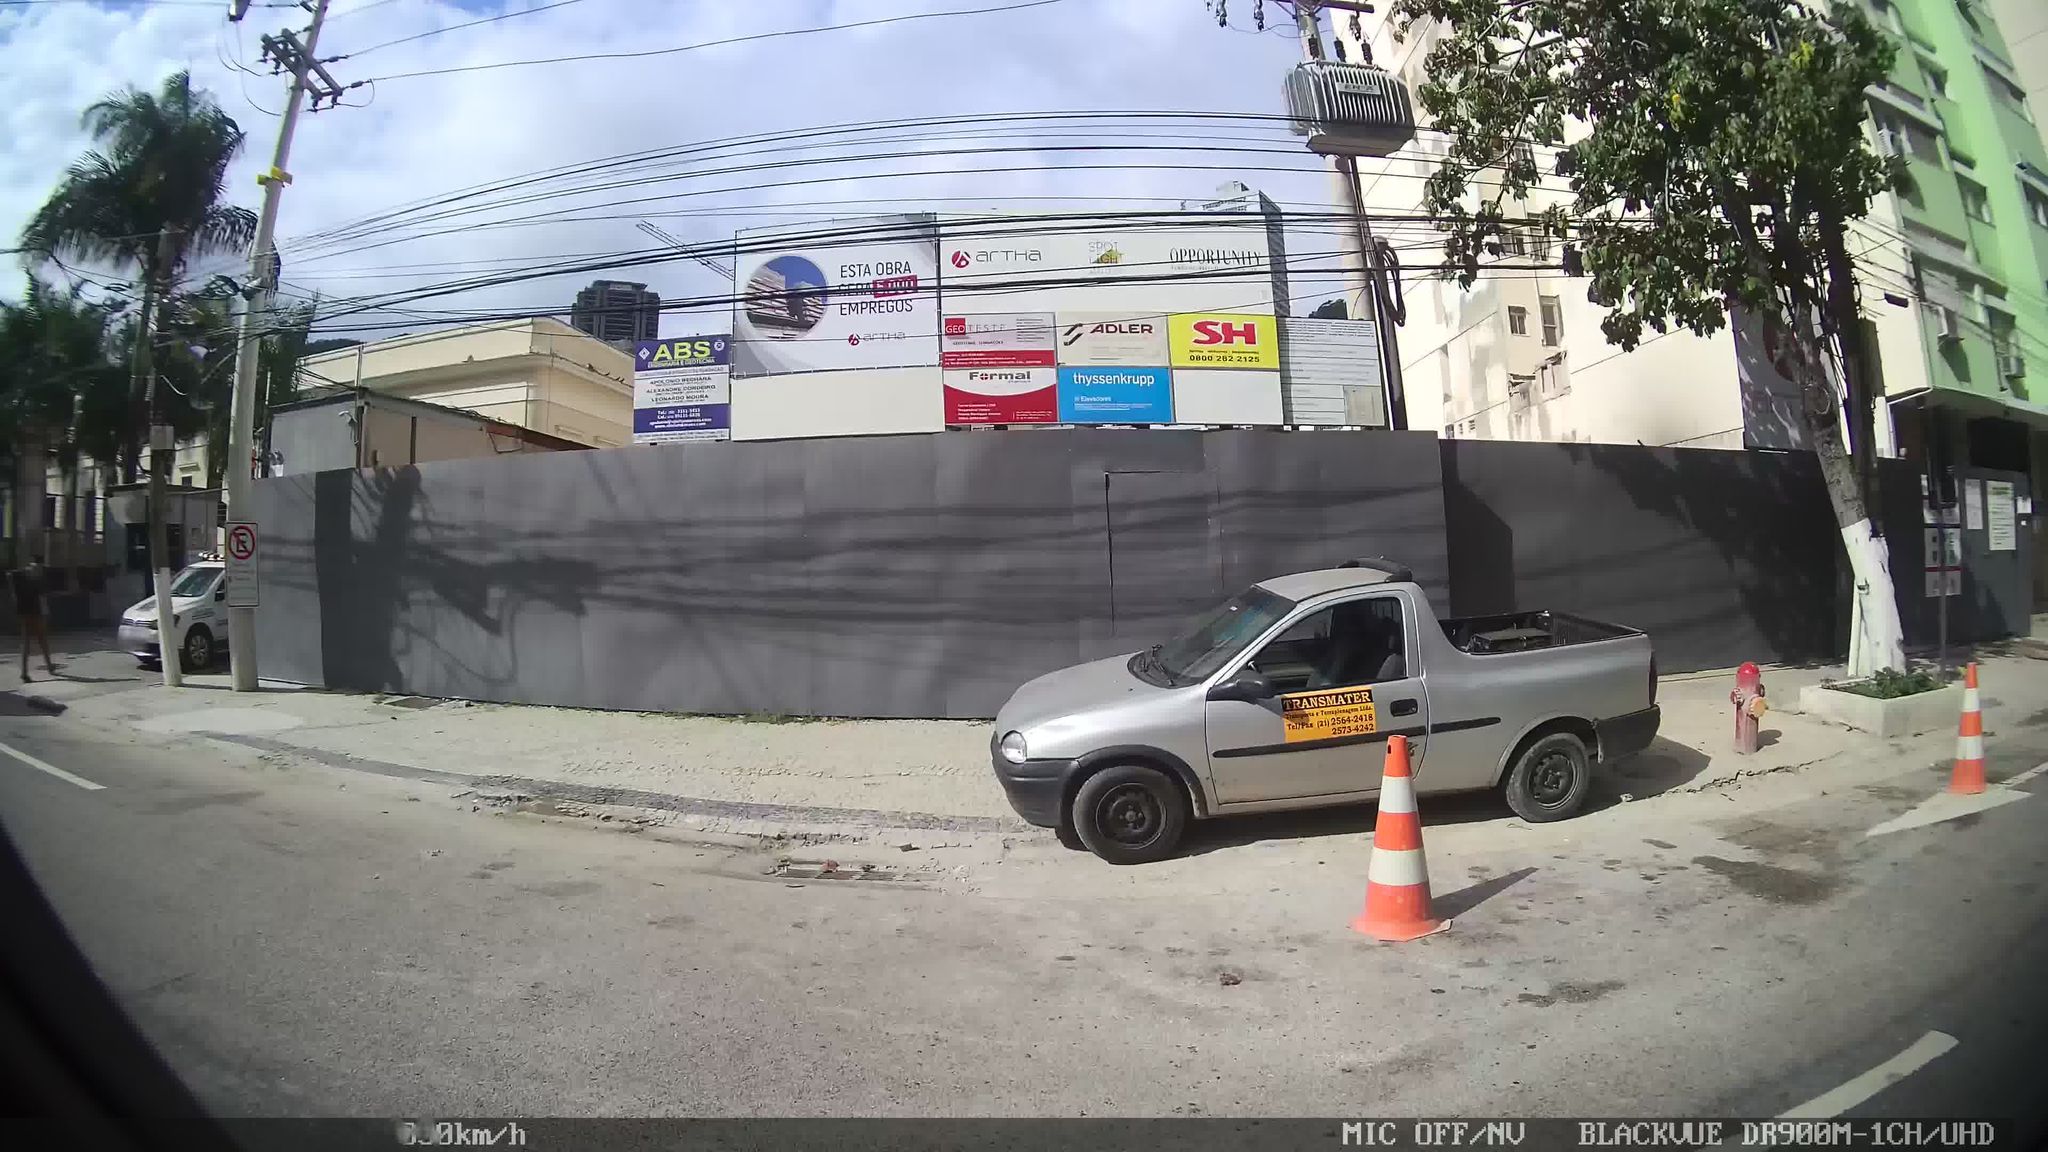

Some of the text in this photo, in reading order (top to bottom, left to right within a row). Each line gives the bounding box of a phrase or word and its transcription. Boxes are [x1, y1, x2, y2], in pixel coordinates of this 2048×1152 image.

[1169, 247, 1261, 266] OPPORTUNITY
[840, 261, 912, 278] ESTA OBRA
[840, 298, 913, 316] EMPREGOS
[1090, 323, 1153, 334] ADLER
[1193, 321, 1257, 345] SH
[653, 341, 711, 362] ABS
[1236, 354, 1260, 362] 2125
[1073, 372, 1155, 387] thyssenkrupp
[1283, 692, 1371, 710] TRANSMATER
[1331, 714, 1374, 725] 2564-2418
[1331, 724, 1374, 735] 2573-4242
